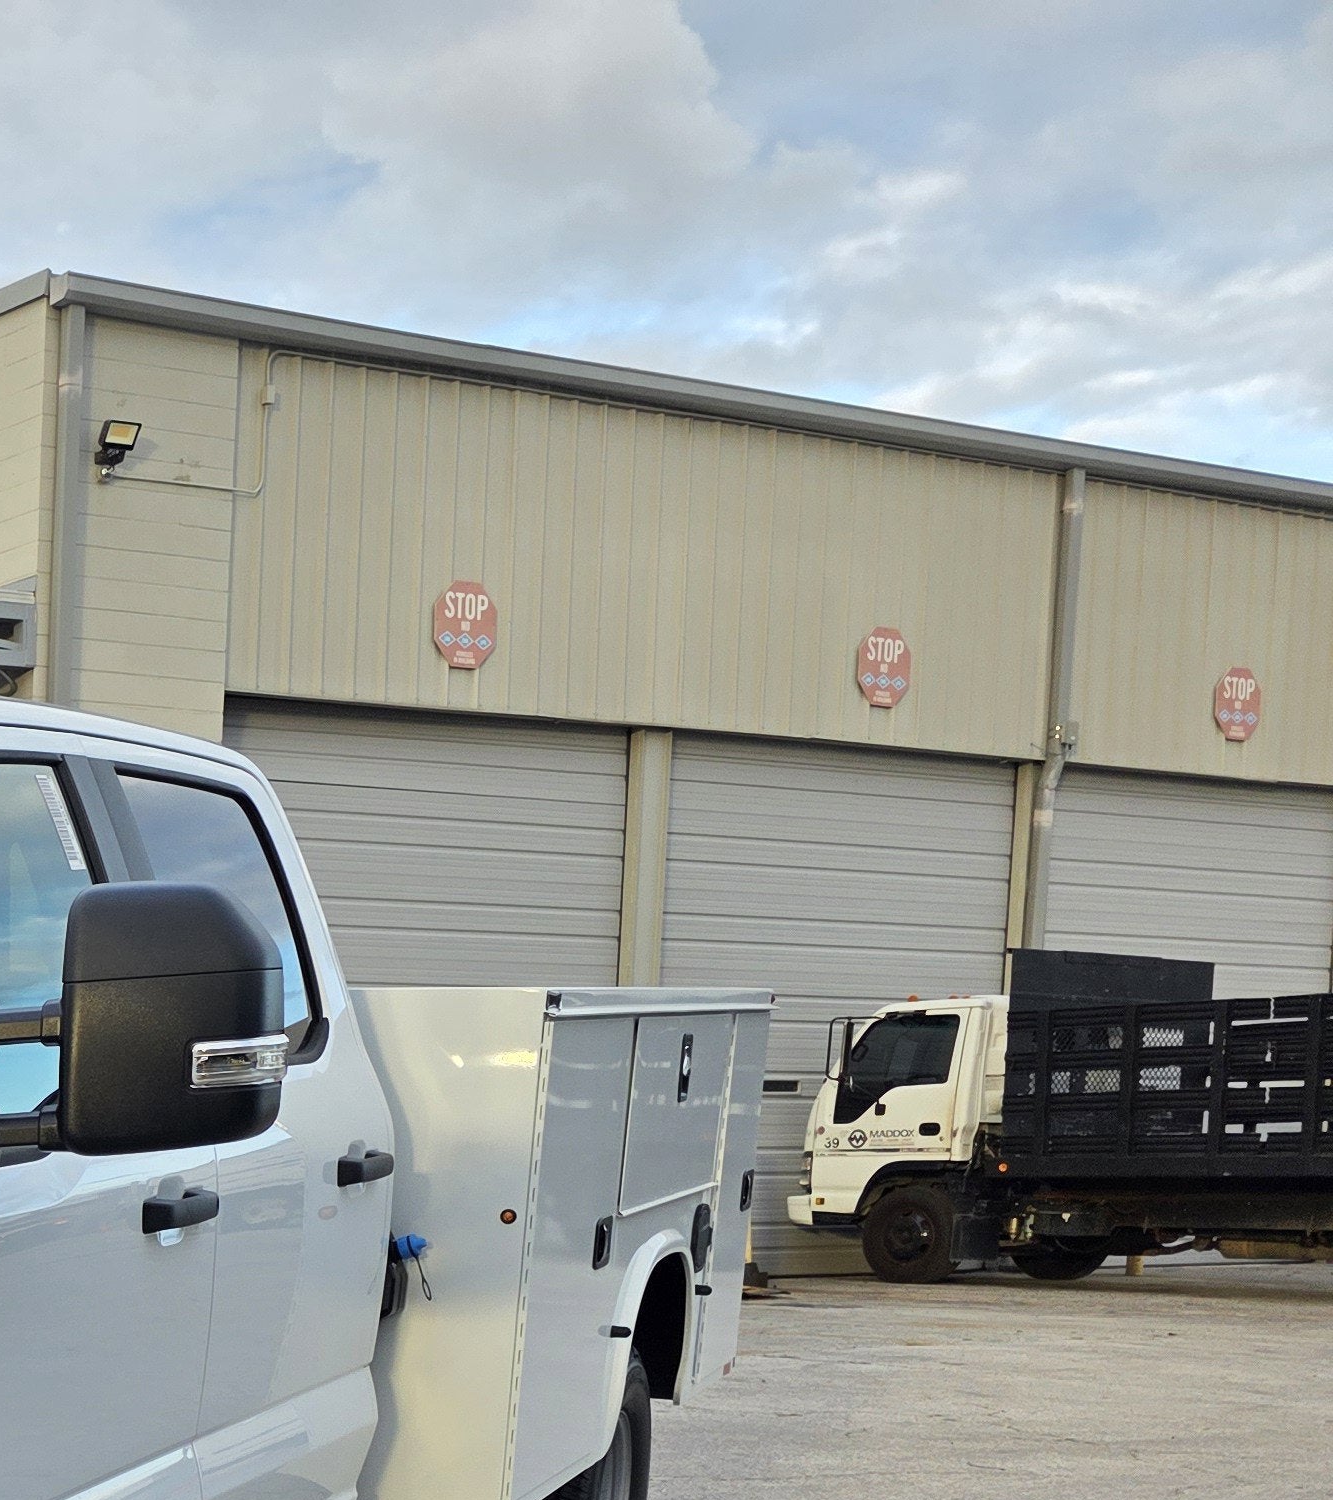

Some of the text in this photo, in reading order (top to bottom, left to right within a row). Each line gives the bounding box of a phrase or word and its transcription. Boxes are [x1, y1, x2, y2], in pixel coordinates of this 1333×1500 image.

[444, 591, 489, 621] STOP
[866, 636, 905, 663] STOP
[1223, 675, 1256, 701] STOP
[824, 1138, 840, 1149] 39
[869, 1129, 915, 1138] MADDOX
